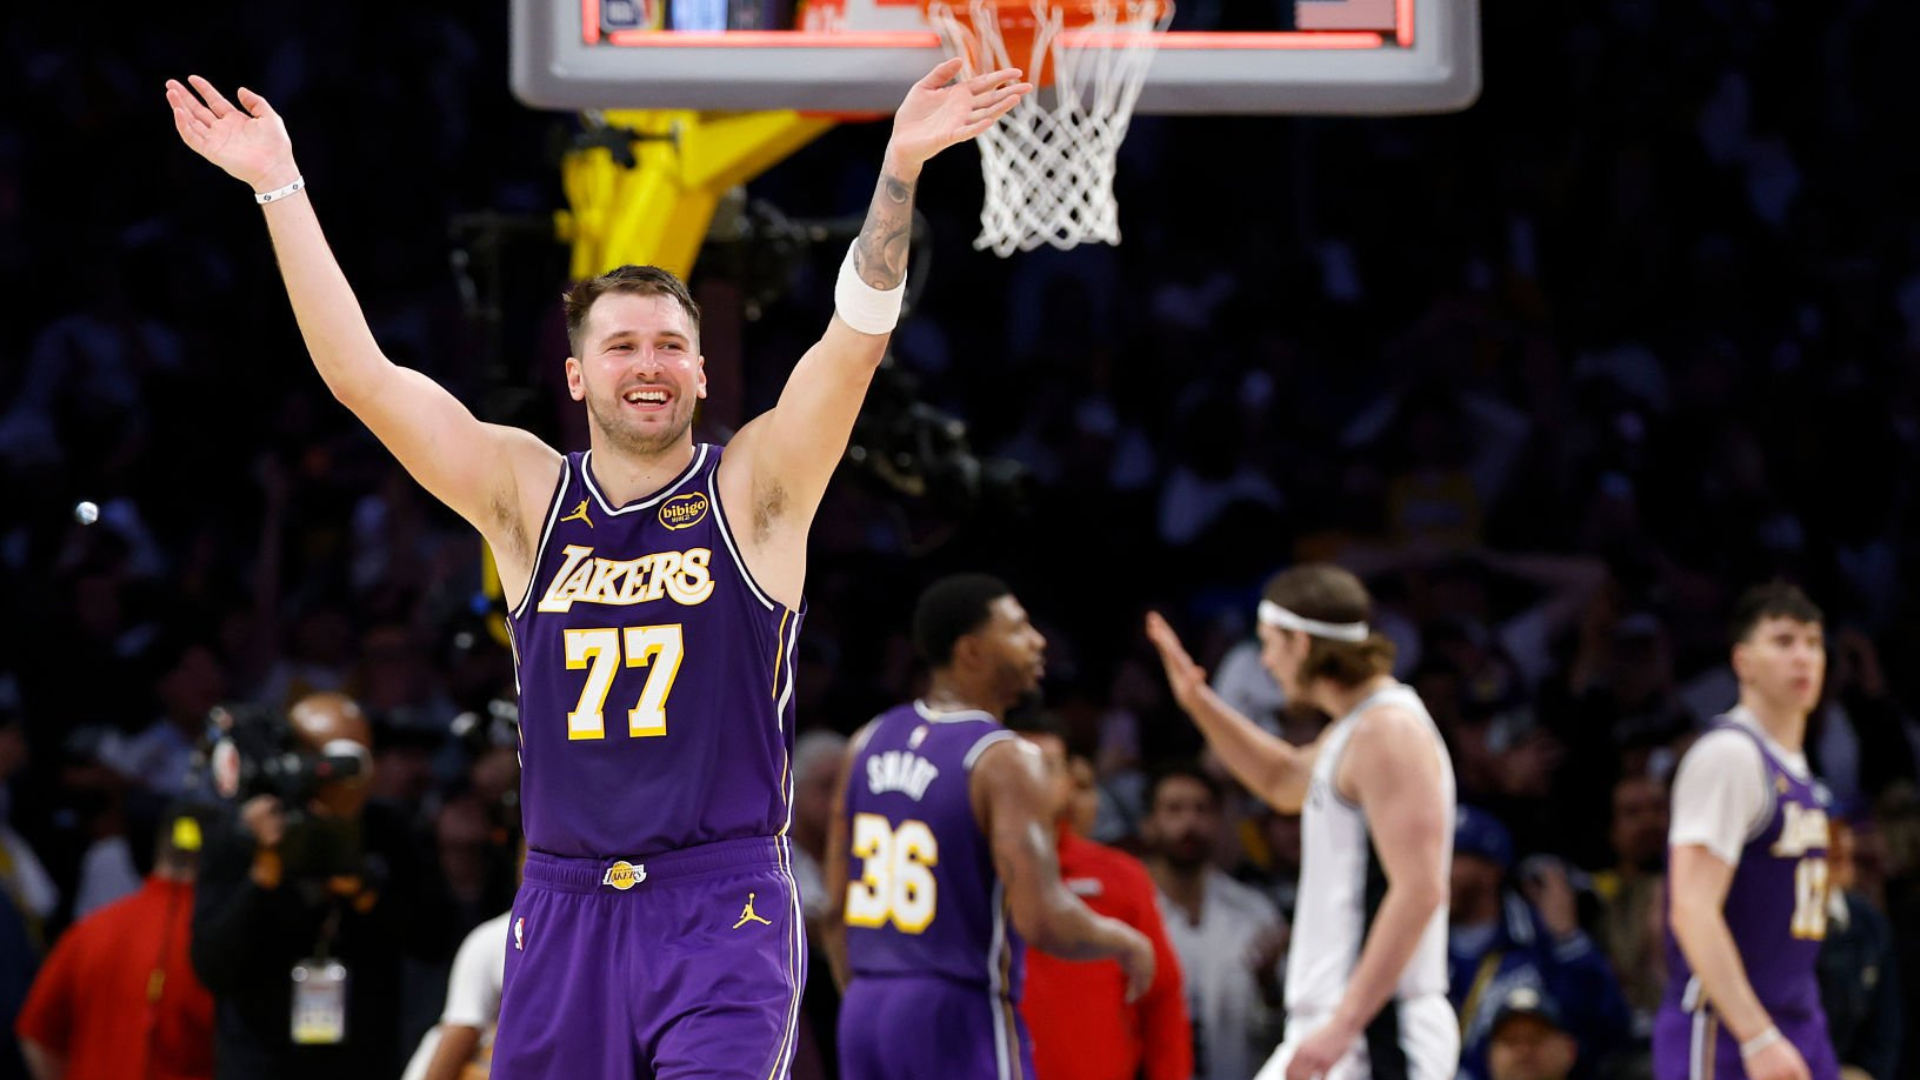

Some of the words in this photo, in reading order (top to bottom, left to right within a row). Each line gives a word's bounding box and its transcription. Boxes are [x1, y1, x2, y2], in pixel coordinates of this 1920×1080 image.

[663, 501, 705, 518] bibigo
[537, 544, 715, 613] LAKERS
[563, 623, 684, 741] 77
[844, 812, 939, 934] 36
